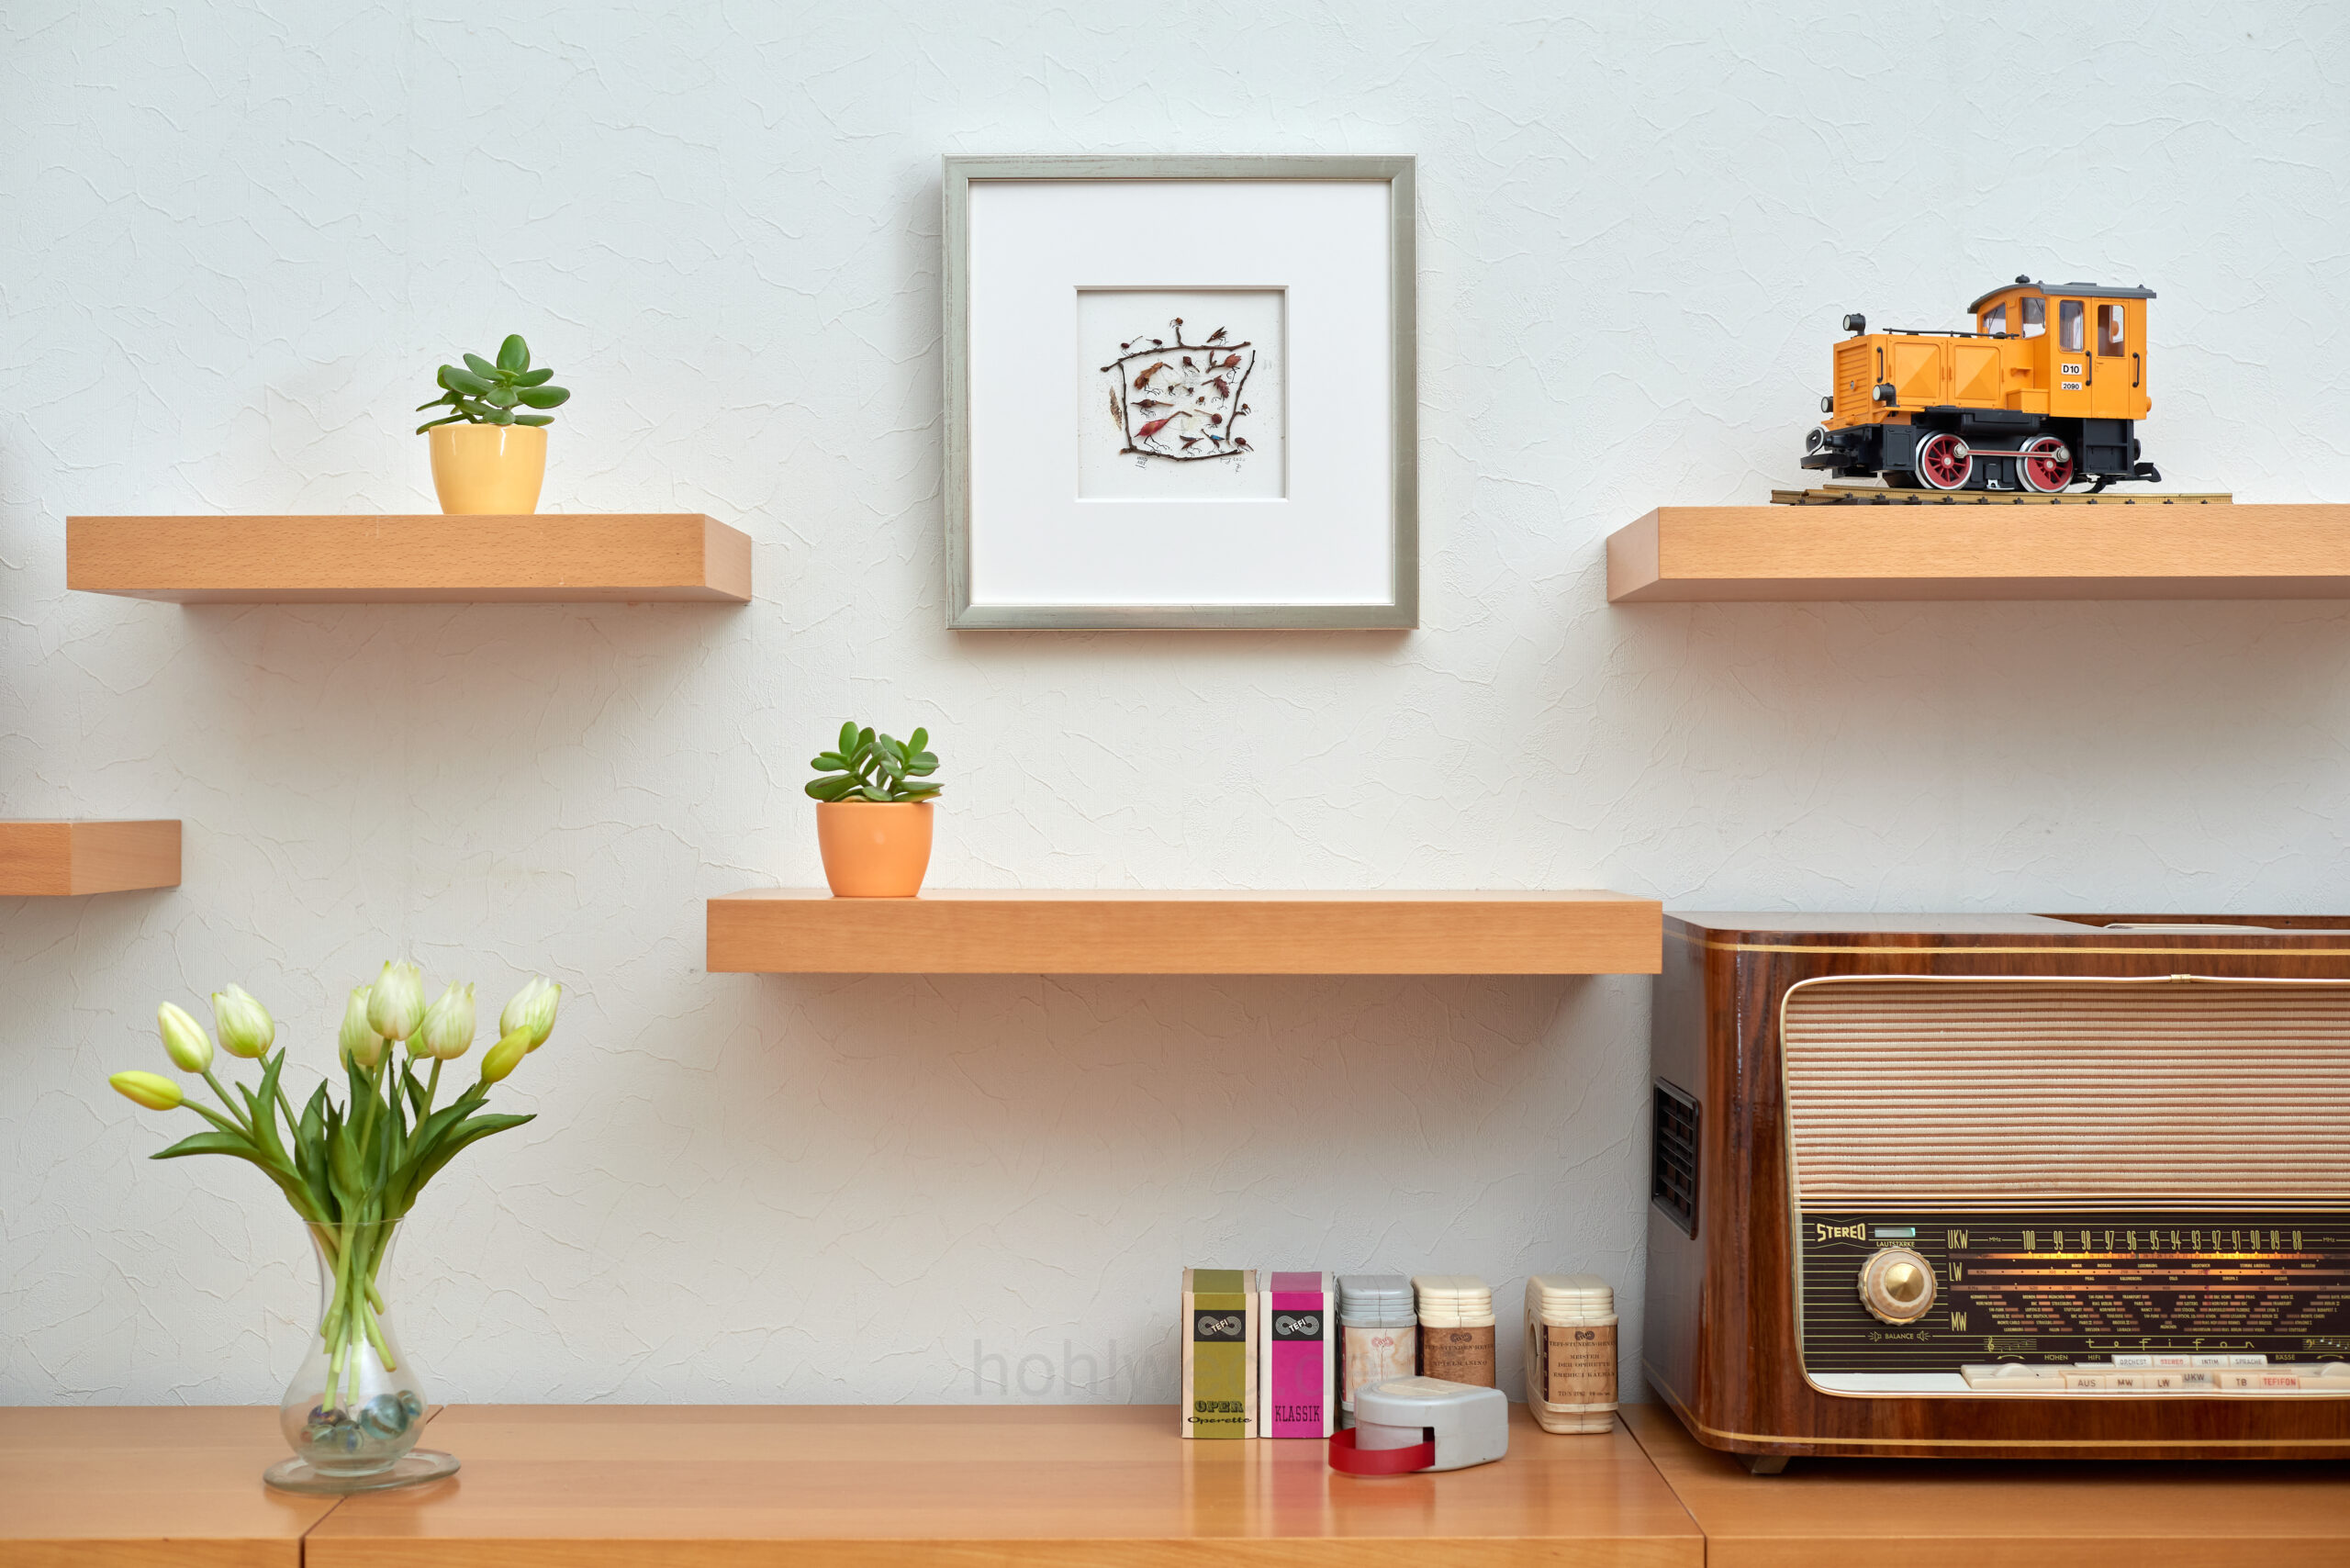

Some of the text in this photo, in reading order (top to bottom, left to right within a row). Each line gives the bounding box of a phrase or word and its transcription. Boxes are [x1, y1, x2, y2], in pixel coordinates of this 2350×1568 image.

[2063, 364, 2080, 374] D10
[1817, 1222, 1866, 1242] STEREO
[1947, 1228, 1969, 1249] UKW
[2022, 1229, 2036, 1250] 100
[2053, 1229, 2065, 1250] 99
[2080, 1229, 2092, 1250] 98
[2104, 1229, 2115, 1250] 97
[2126, 1229, 2137, 1250] 96
[2149, 1229, 2160, 1250] 95
[2170, 1229, 2182, 1250] 94
[2190, 1229, 2202, 1250] 93
[2211, 1229, 2222, 1250] 92
[2232, 1229, 2242, 1250] 91
[2250, 1229, 2261, 1250] 90
[2269, 1229, 2281, 1250] 89
[2291, 1229, 2303, 1250] 88
[1948, 1261, 1963, 1282] LW
[1211, 1319, 1229, 1332] TEFI
[1289, 1318, 1307, 1332] TEFI
[1951, 1311, 1967, 1332] MW
[1885, 1332, 1915, 1340] BALANCE
[2077, 1379, 2096, 1387] AUS
[2117, 1379, 2134, 1387] MW
[2156, 1379, 2170, 1387] LW
[2184, 1373, 2205, 1382] UKW
[2236, 1378, 2248, 1387] TB
[2263, 1377, 2297, 1386] TEFIFON
[1194, 1400, 1245, 1413] OPER
[1274, 1405, 1321, 1422] KLASSIK
